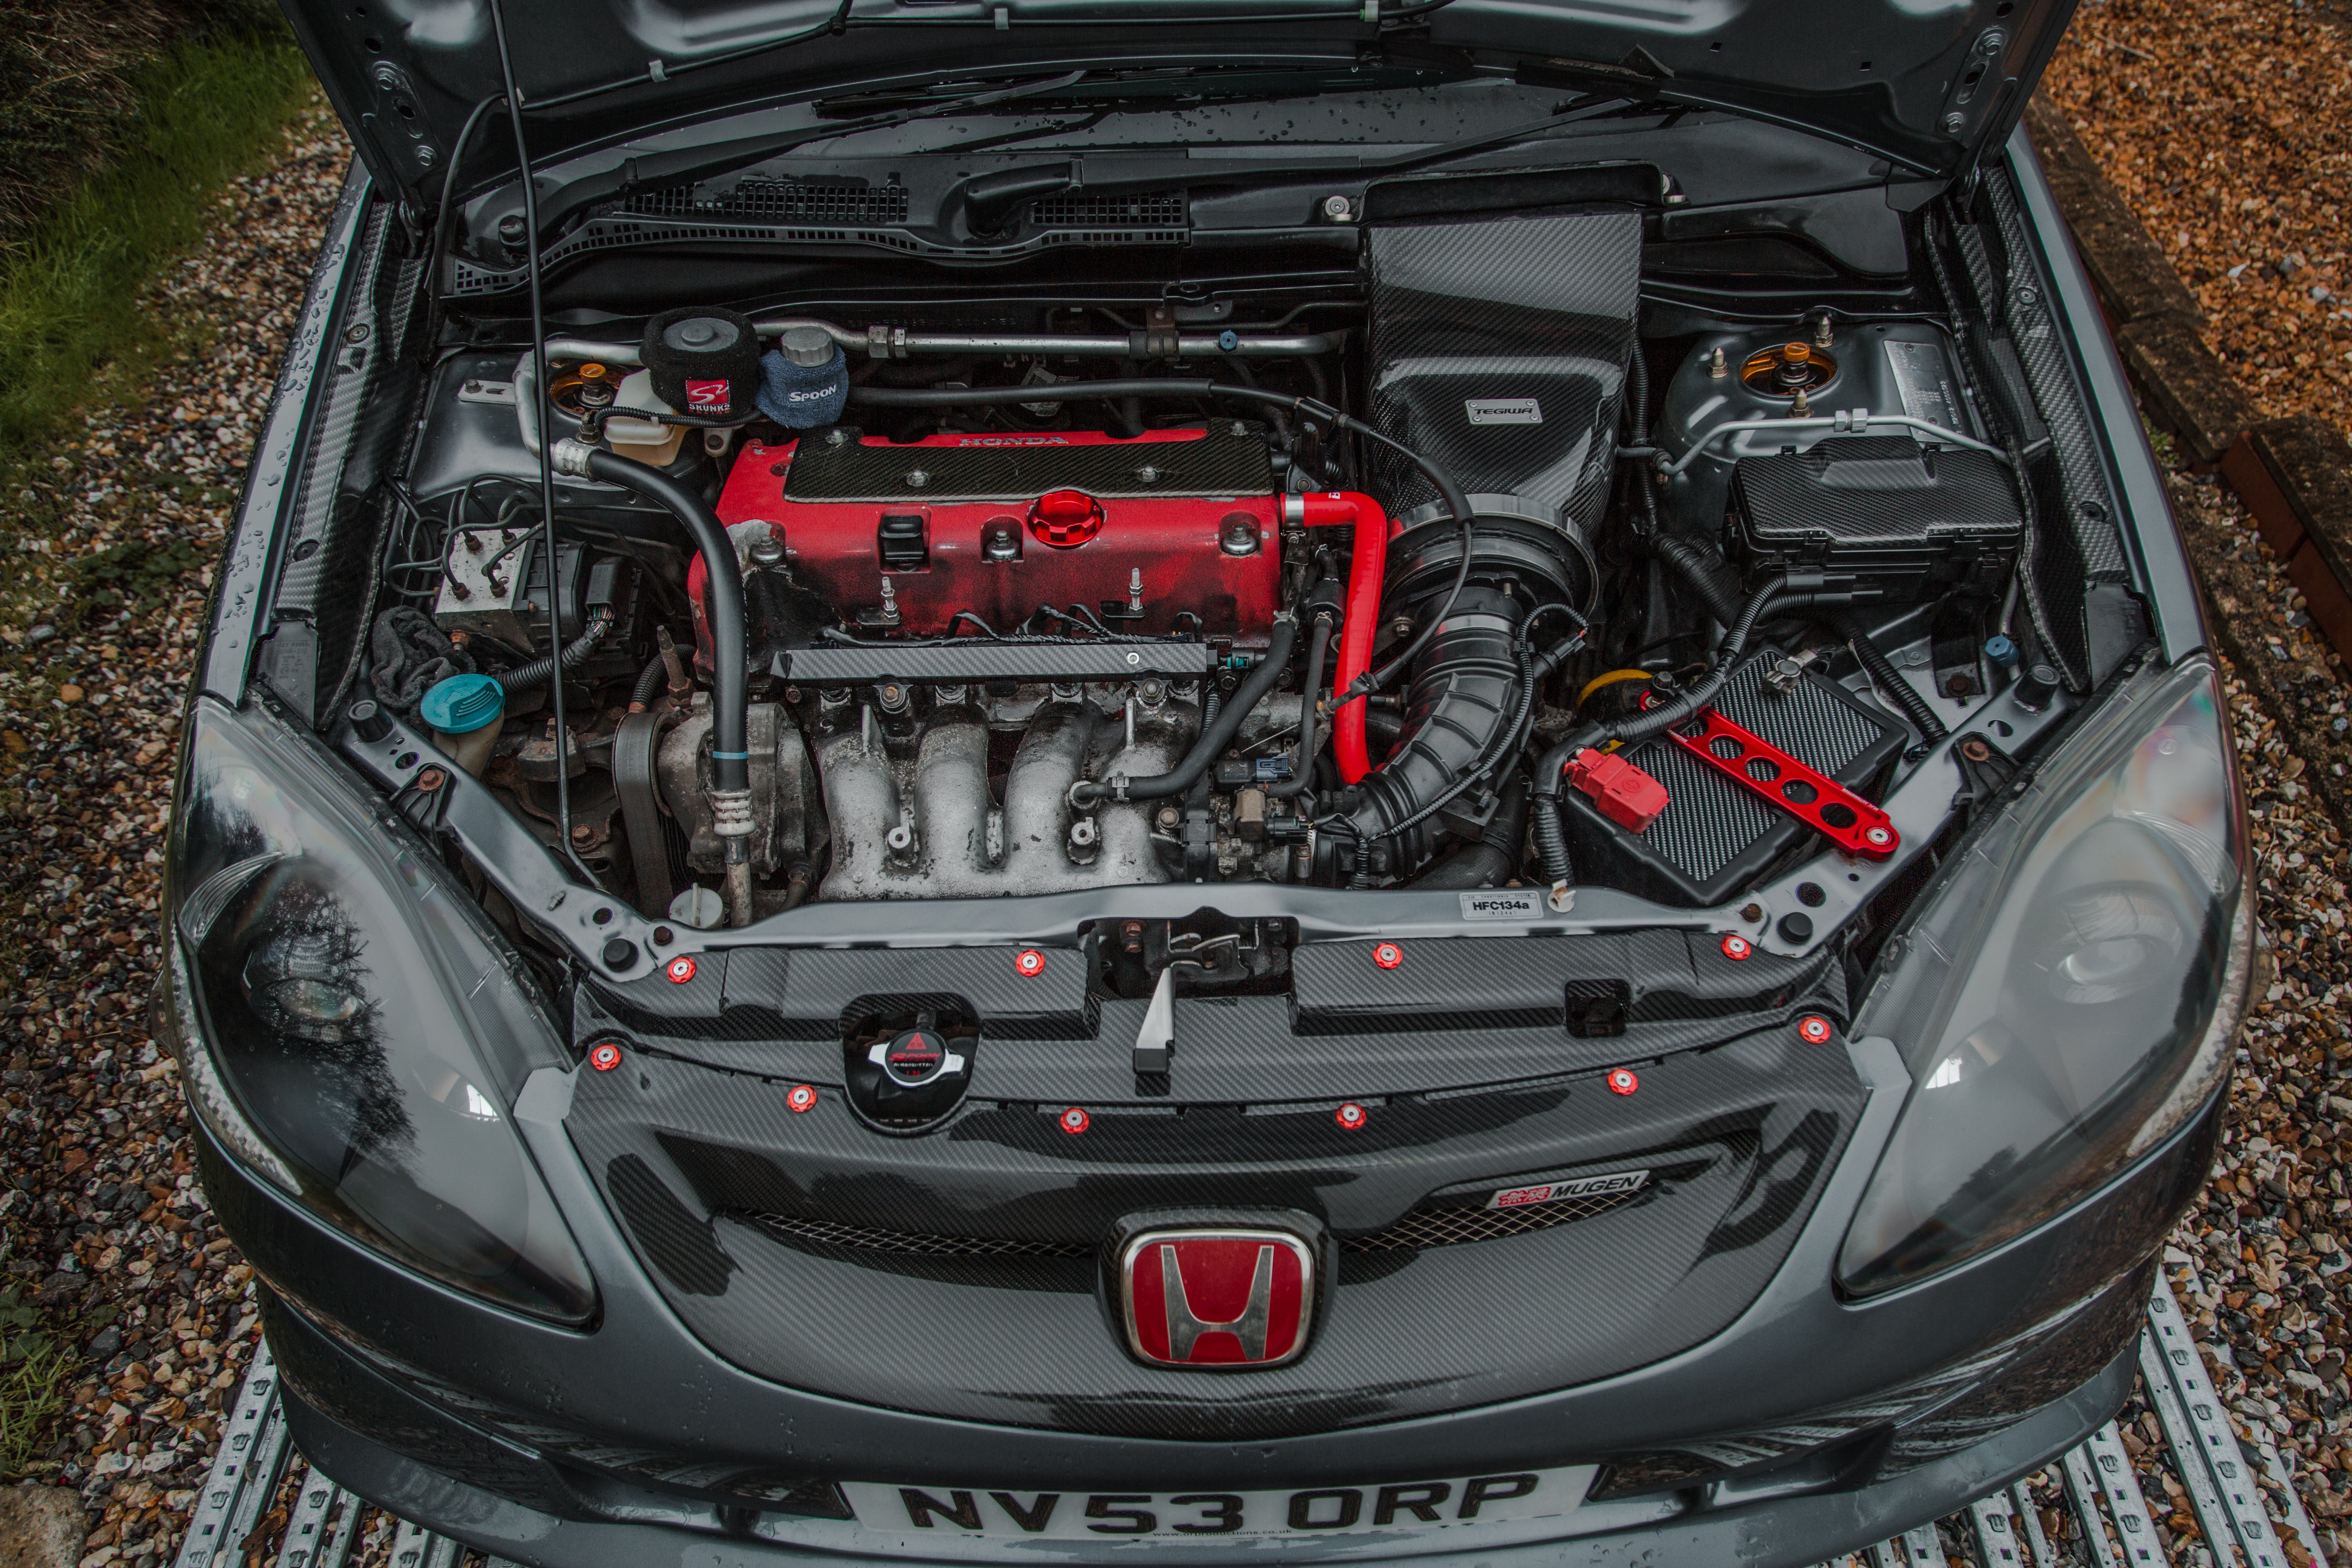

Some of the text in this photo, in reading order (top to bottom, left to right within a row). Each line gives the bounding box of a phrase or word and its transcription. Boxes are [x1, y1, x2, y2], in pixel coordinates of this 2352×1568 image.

[789, 385, 837, 402] SPOON
[959, 437, 1069, 446] HONDA
[1842, 788, 1869, 805] AUTOMOTIVE
[1472, 901, 1530, 911] HFC134a
[1552, 1175, 1641, 1198] MUGEN
[899, 1473, 1539, 1534] NV53 ORP
